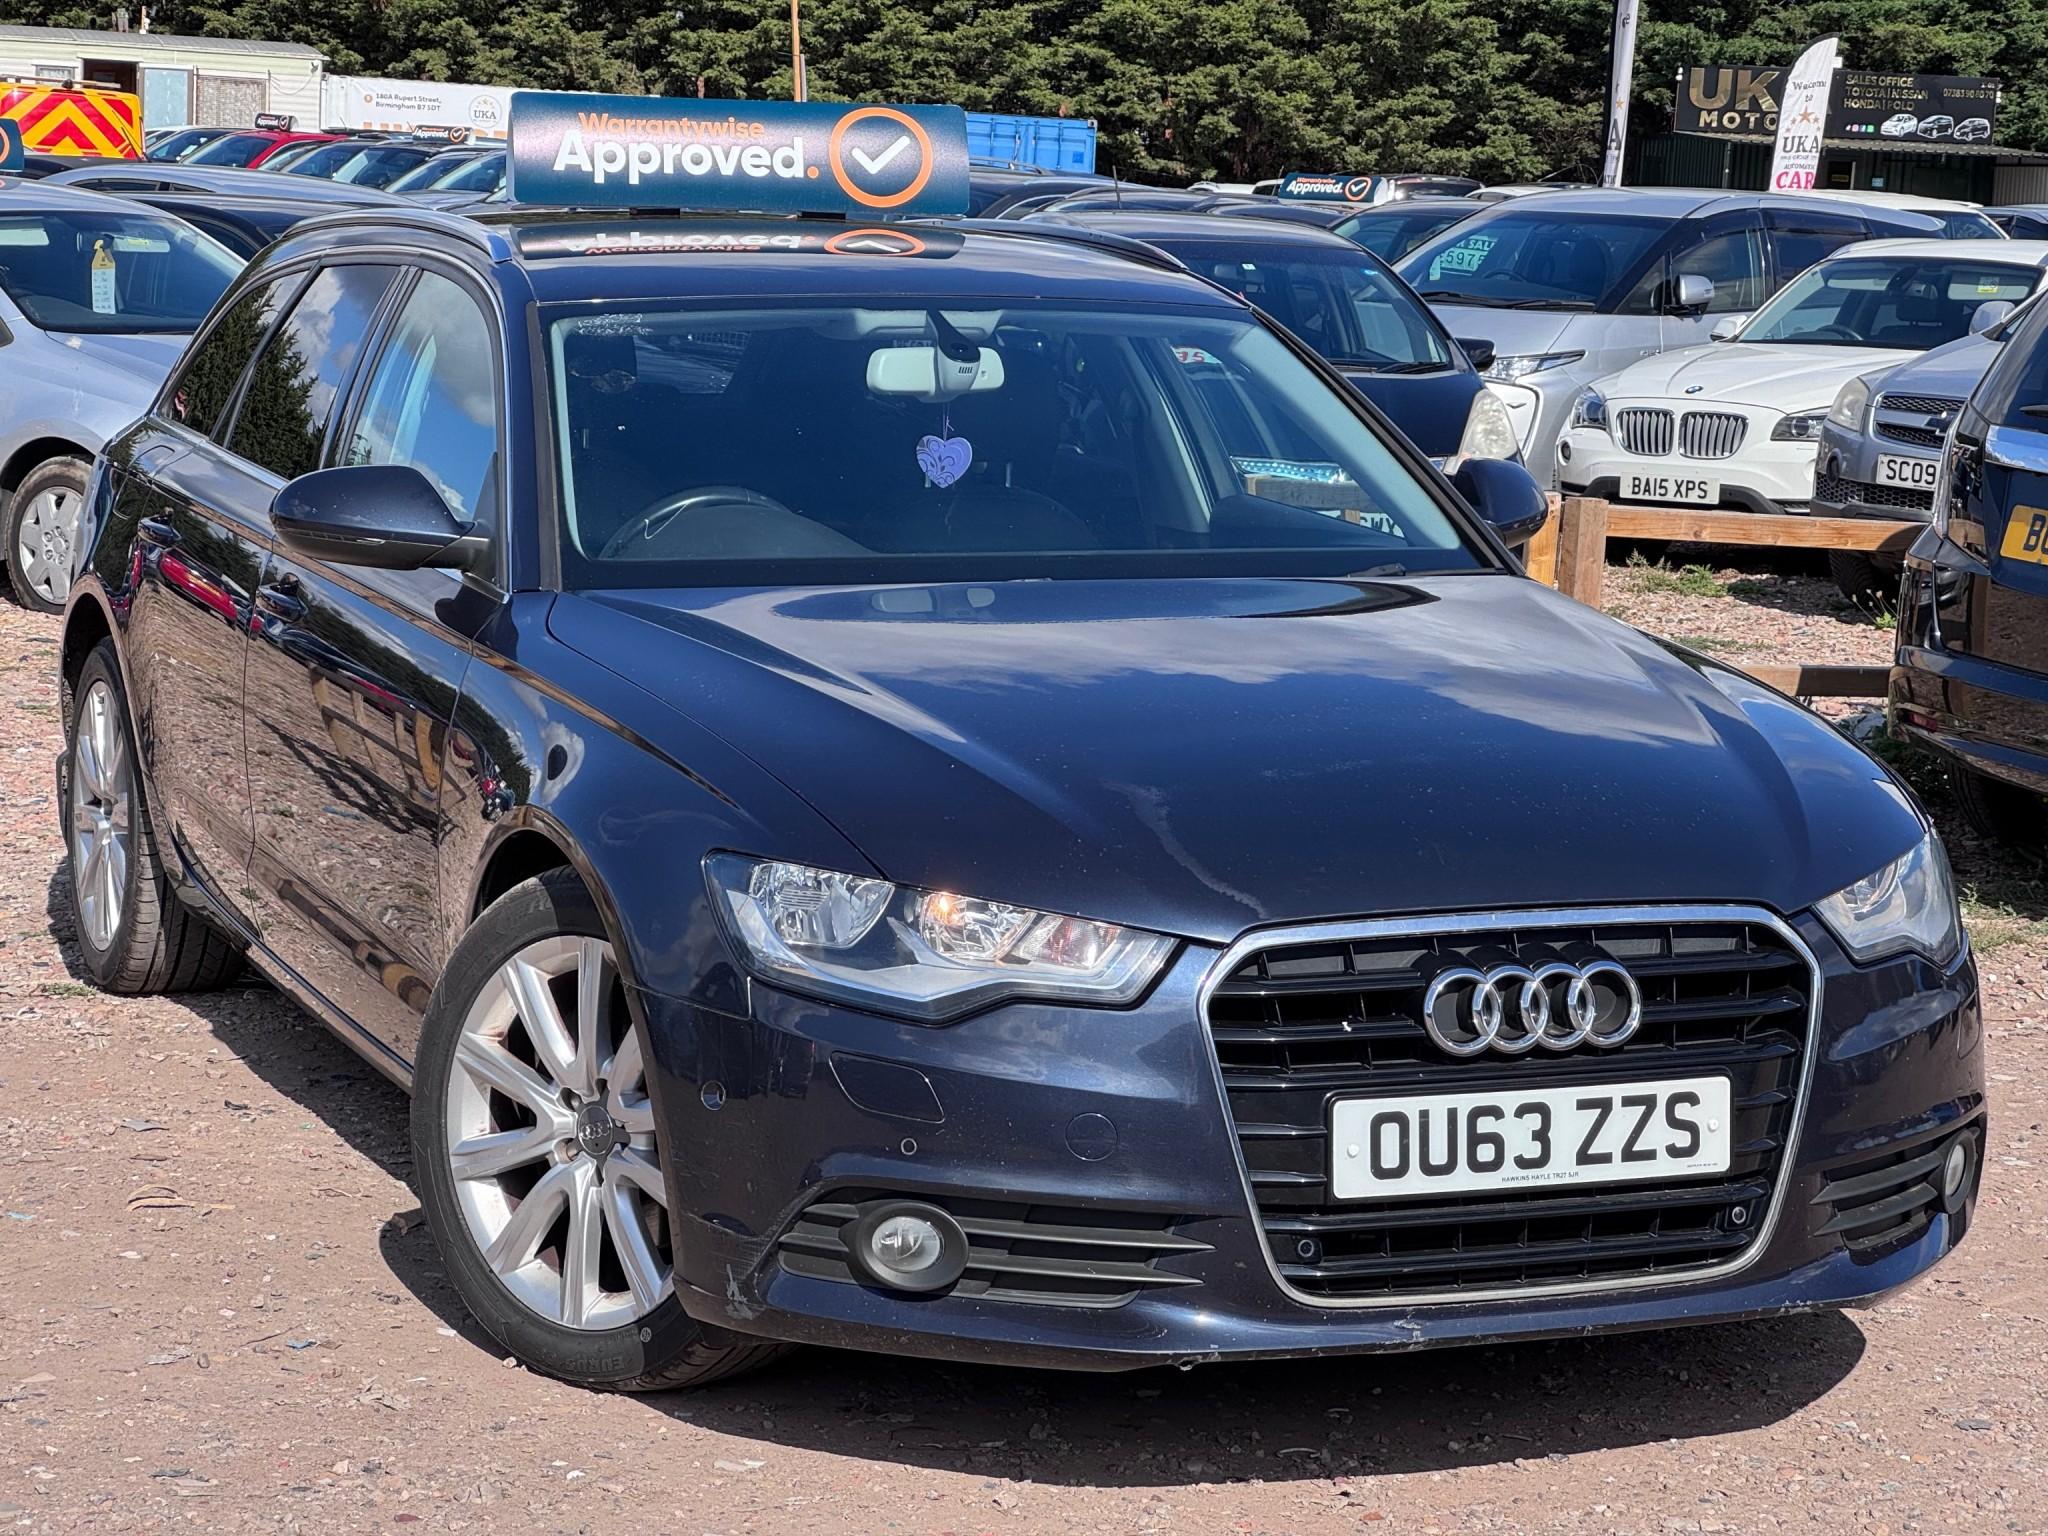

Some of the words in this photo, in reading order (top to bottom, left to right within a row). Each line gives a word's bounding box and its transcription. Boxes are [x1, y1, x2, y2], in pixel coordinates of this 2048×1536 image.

[1689, 67, 1780, 112] UK
[1846, 74, 1878, 86] SALES
[1878, 76, 1914, 88] OFFICE
[1845, 86, 1886, 97] TOYOTA
[1891, 88, 1929, 99] NISSAN
[1843, 98, 1881, 110] HONDA
[474, 109, 497, 120] UKA
[1699, 110, 1778, 131] MOTO
[578, 112, 765, 140] Warrantywise
[1782, 135, 1820, 154] UKA
[553, 129, 820, 184] Approved.
[1775, 170, 1816, 190] CAR
[1886, 459, 1937, 485] SC09
[1631, 476, 1668, 497] BA15
[1673, 479, 1708, 499] XPS
[1369, 1101, 1552, 1180] OU63
[1575, 1090, 1701, 1167] ZZS
[1501, 1174, 1530, 1183] HAWKINS
[1531, 1172, 1551, 1180] HAYLE
[1552, 1171, 1567, 1179] TR27
